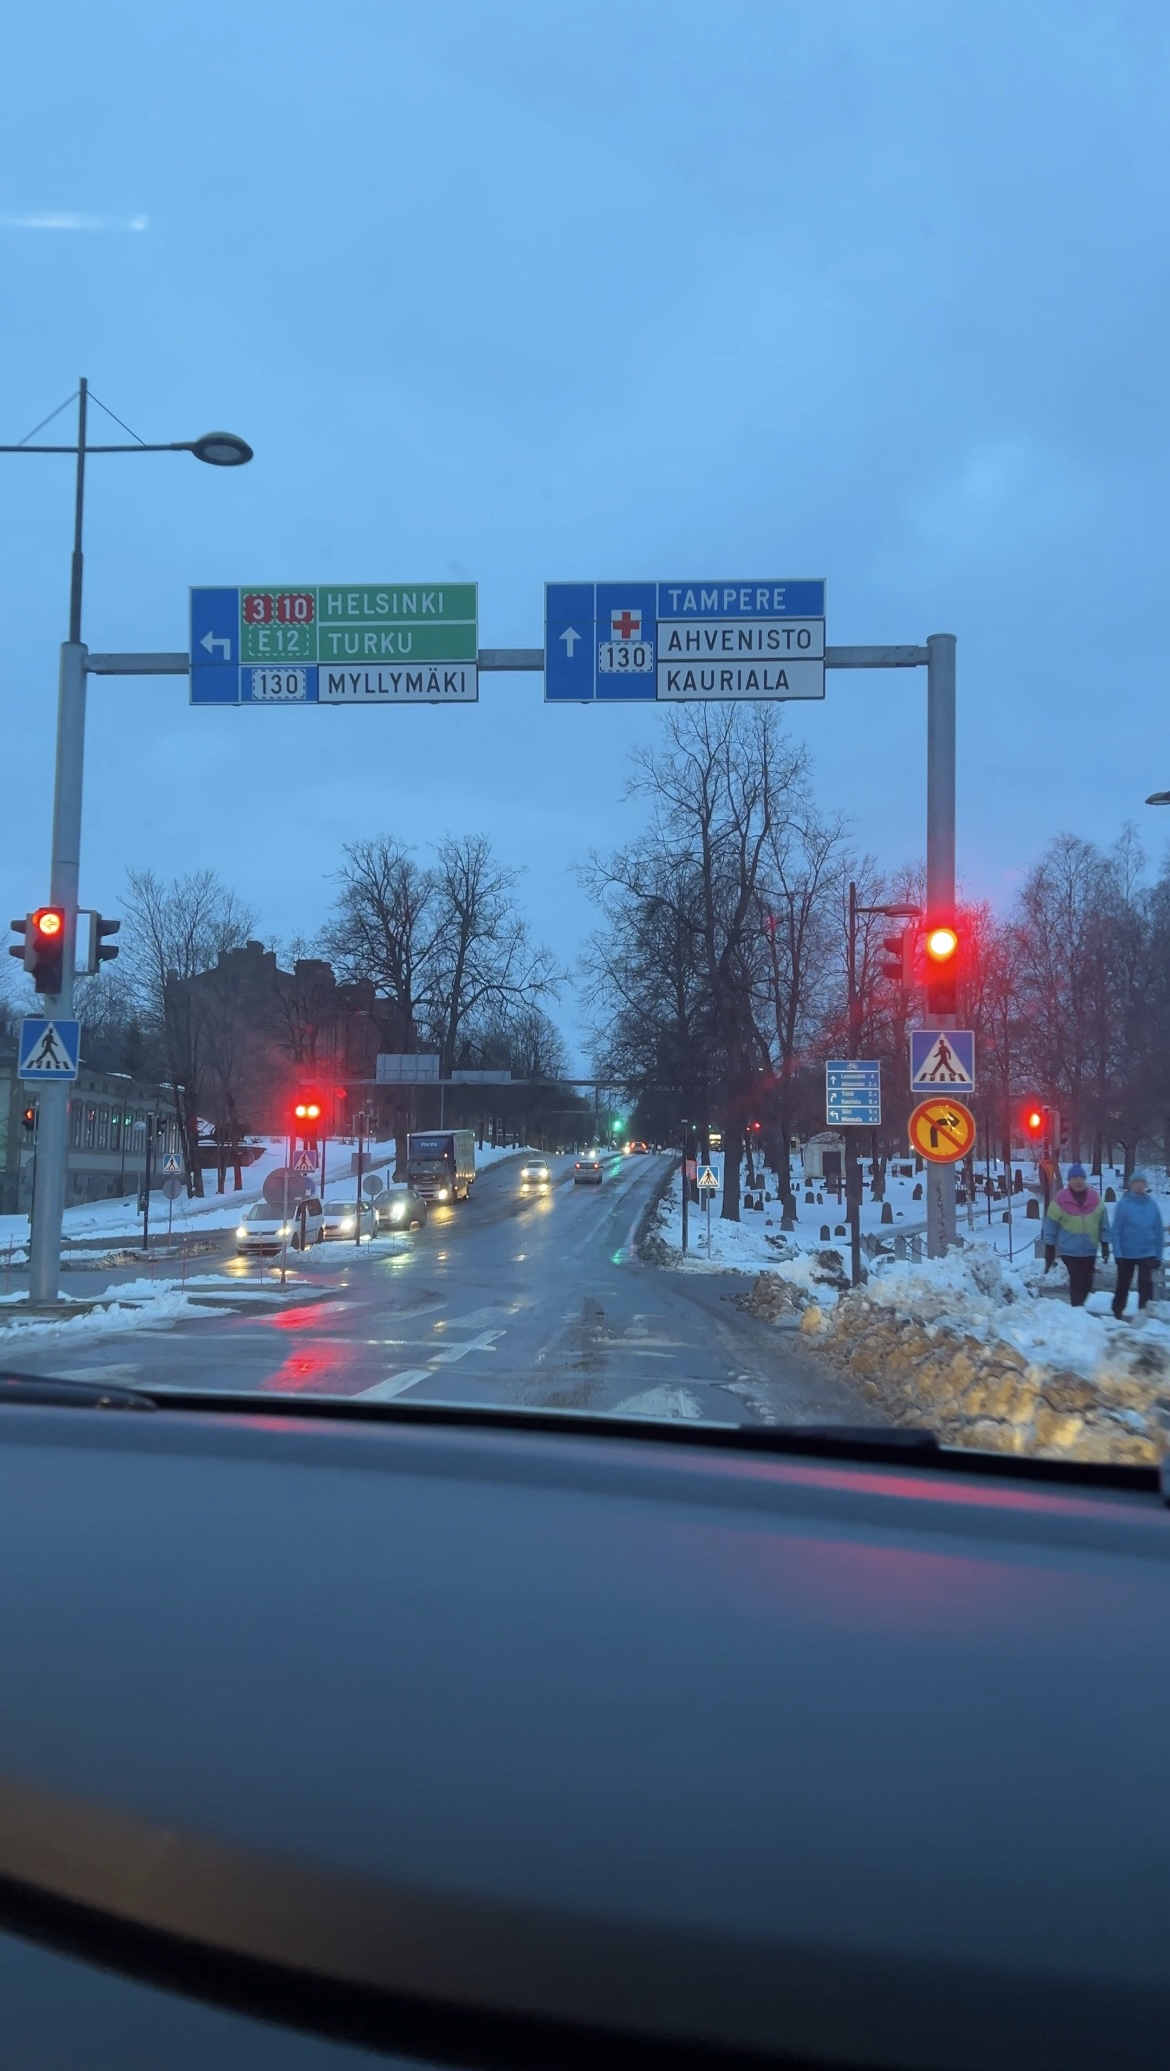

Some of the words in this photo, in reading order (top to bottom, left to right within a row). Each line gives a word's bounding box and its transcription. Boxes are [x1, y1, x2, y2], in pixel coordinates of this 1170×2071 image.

[252, 598, 265, 620] 3
[283, 597, 308, 620] 10
[327, 592, 444, 615] HELSINKI
[668, 587, 787, 611] TAMPERE
[258, 629, 300, 652] E12
[328, 632, 413, 655] TURKU
[668, 628, 812, 651] AHVENISTO
[607, 646, 646, 668] 130
[260, 674, 299, 695] 130
[328, 667, 466, 695] MYLLYMÄKI
[667, 668, 790, 692] KAURIALA
